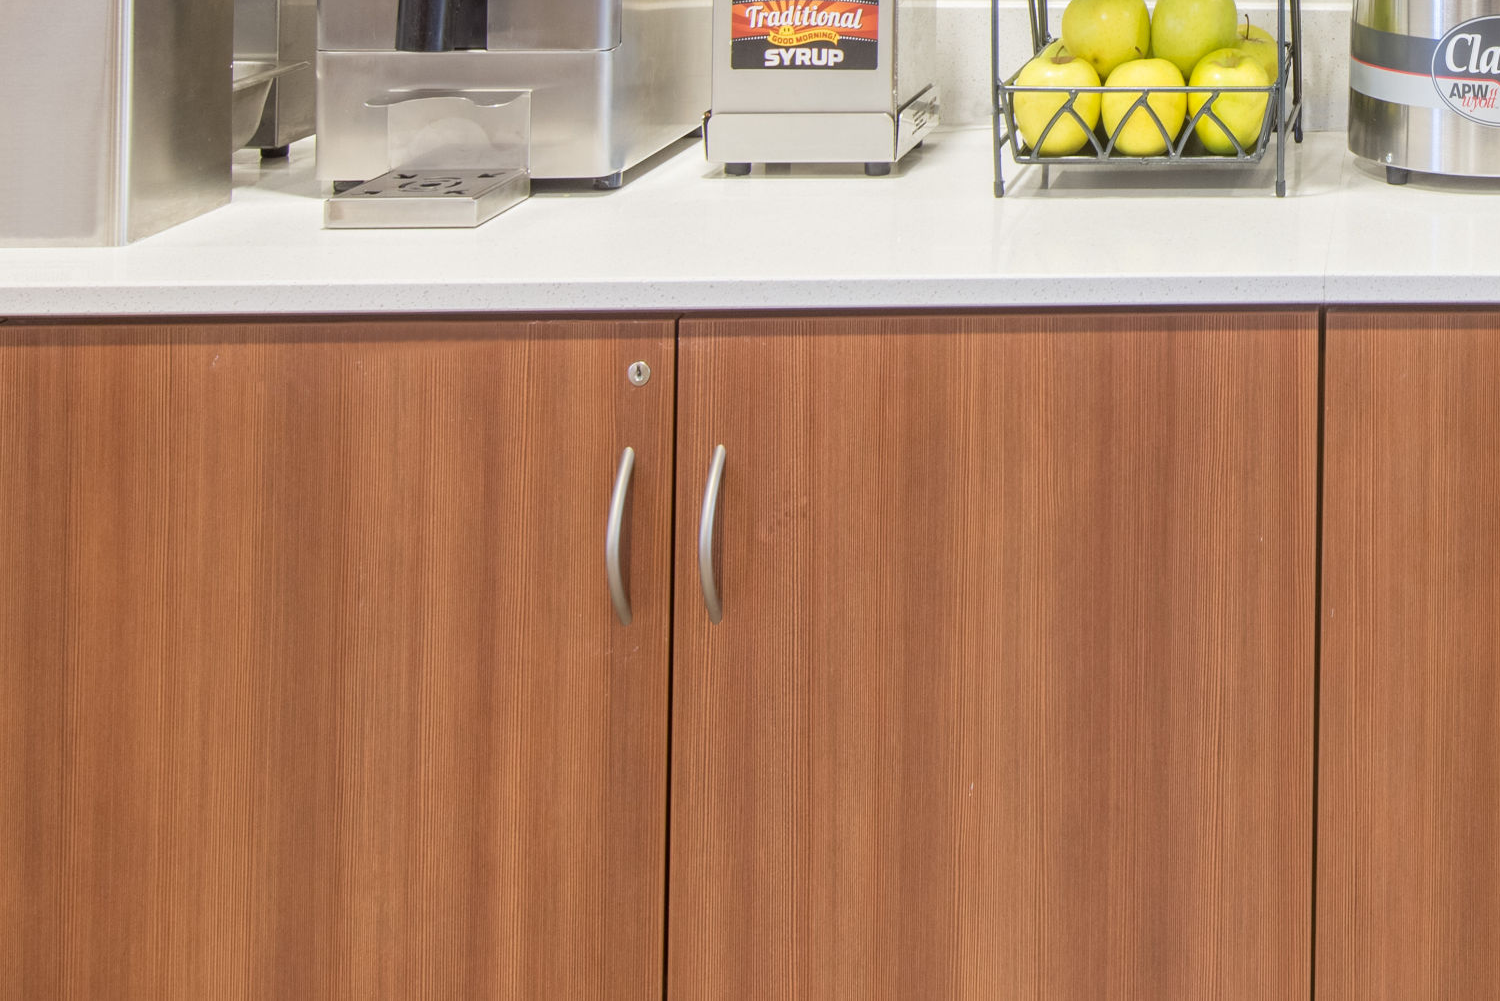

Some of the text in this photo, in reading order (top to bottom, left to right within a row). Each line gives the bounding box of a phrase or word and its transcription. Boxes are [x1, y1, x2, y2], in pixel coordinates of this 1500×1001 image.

[745, 4, 863, 29] Traditional
[772, 31, 837, 45] GOOD MORNING!
[764, 47, 845, 67] SYRUP
[1449, 82, 1489, 100] APW
